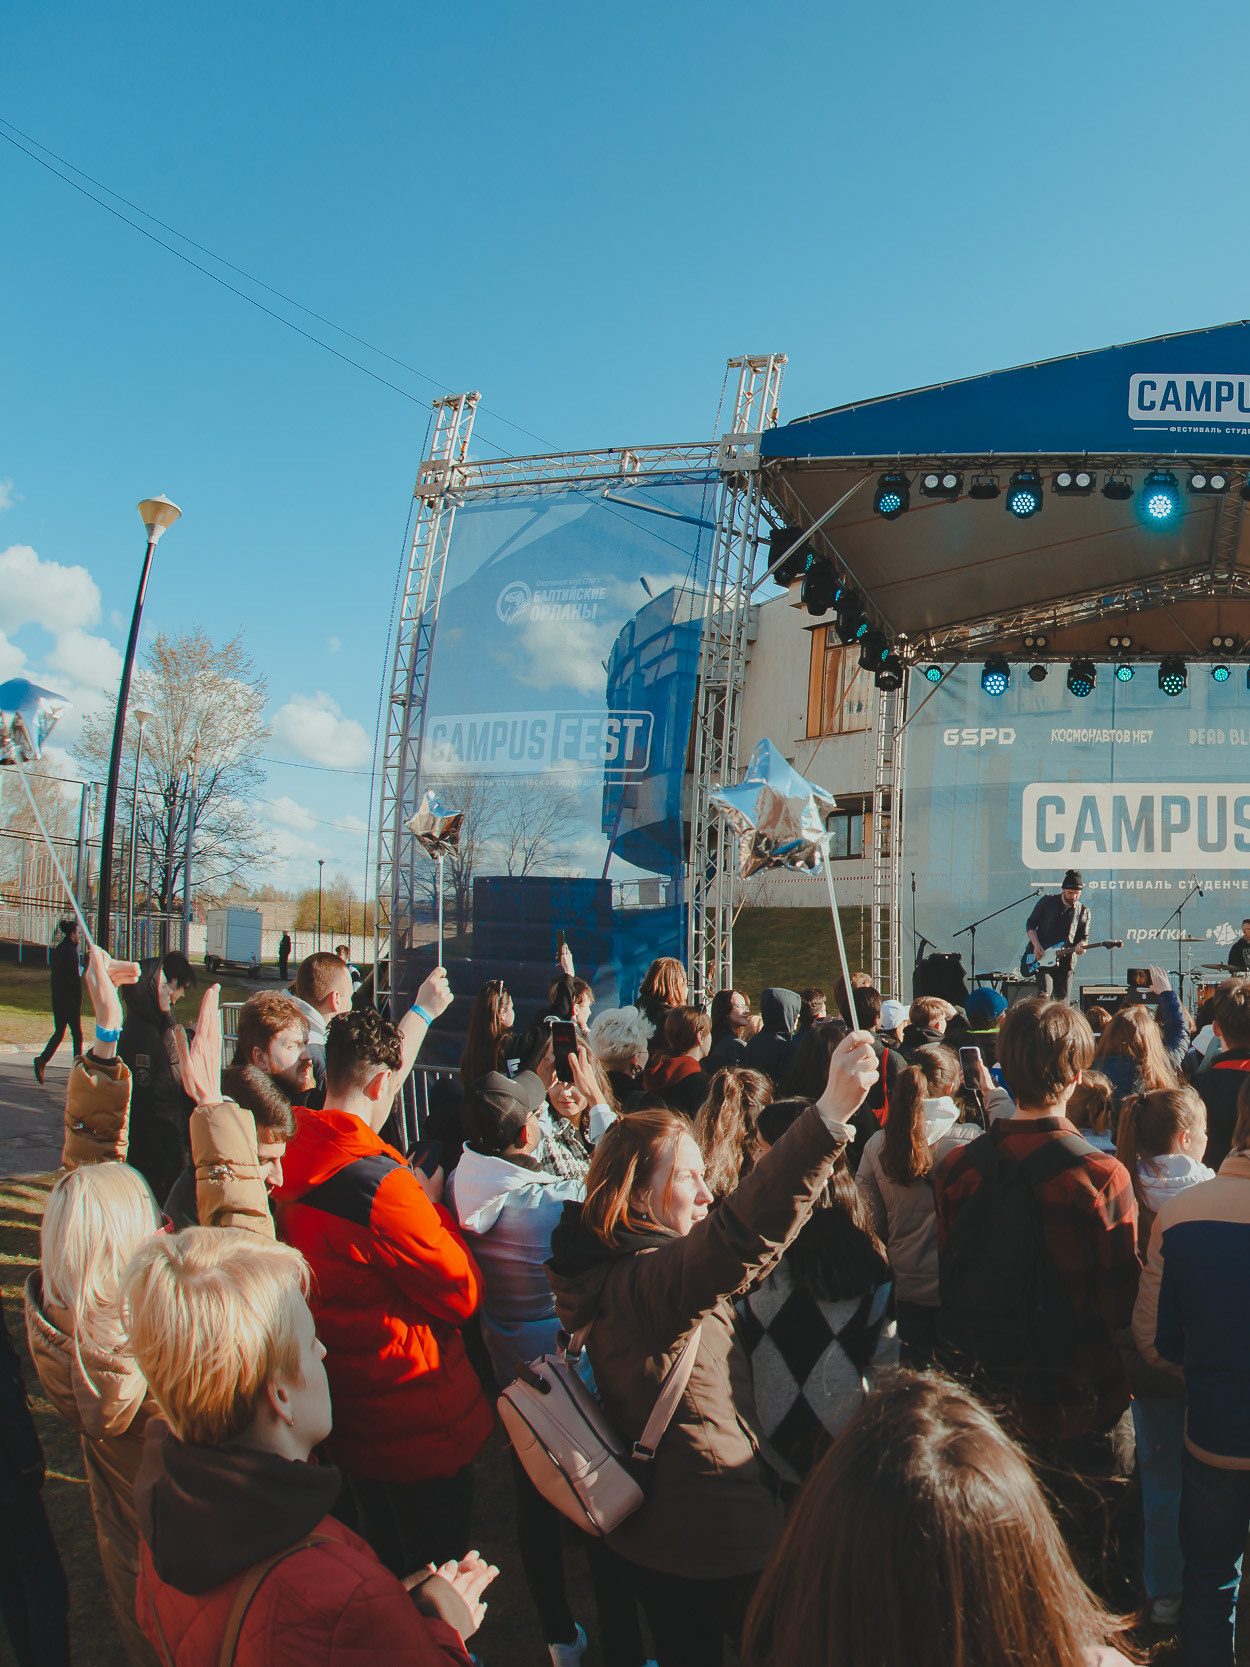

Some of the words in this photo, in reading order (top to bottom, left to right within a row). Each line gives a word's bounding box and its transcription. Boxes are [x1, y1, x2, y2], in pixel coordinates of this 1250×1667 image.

[1169, 426, 1222, 434] ФЕСТИВАЛЬ
[533, 586, 608, 602] БАЛТИЙСКИЕ
[530, 602, 598, 622] ОРЛАНЫ
[431, 719, 547, 763] CAMPUS
[560, 718, 644, 761] FEST
[943, 728, 1017, 747] GSPD
[1050, 728, 1131, 745] КОСМОНАВТОВ
[1132, 729, 1154, 746] НЕТ
[1189, 728, 1225, 745] DEAD
[558, 778, 607, 787] МОЛОДЕИ
[1088, 880, 1172, 890] ФЕСТИВАЛЬ
[1126, 928, 1187, 943] прятки
